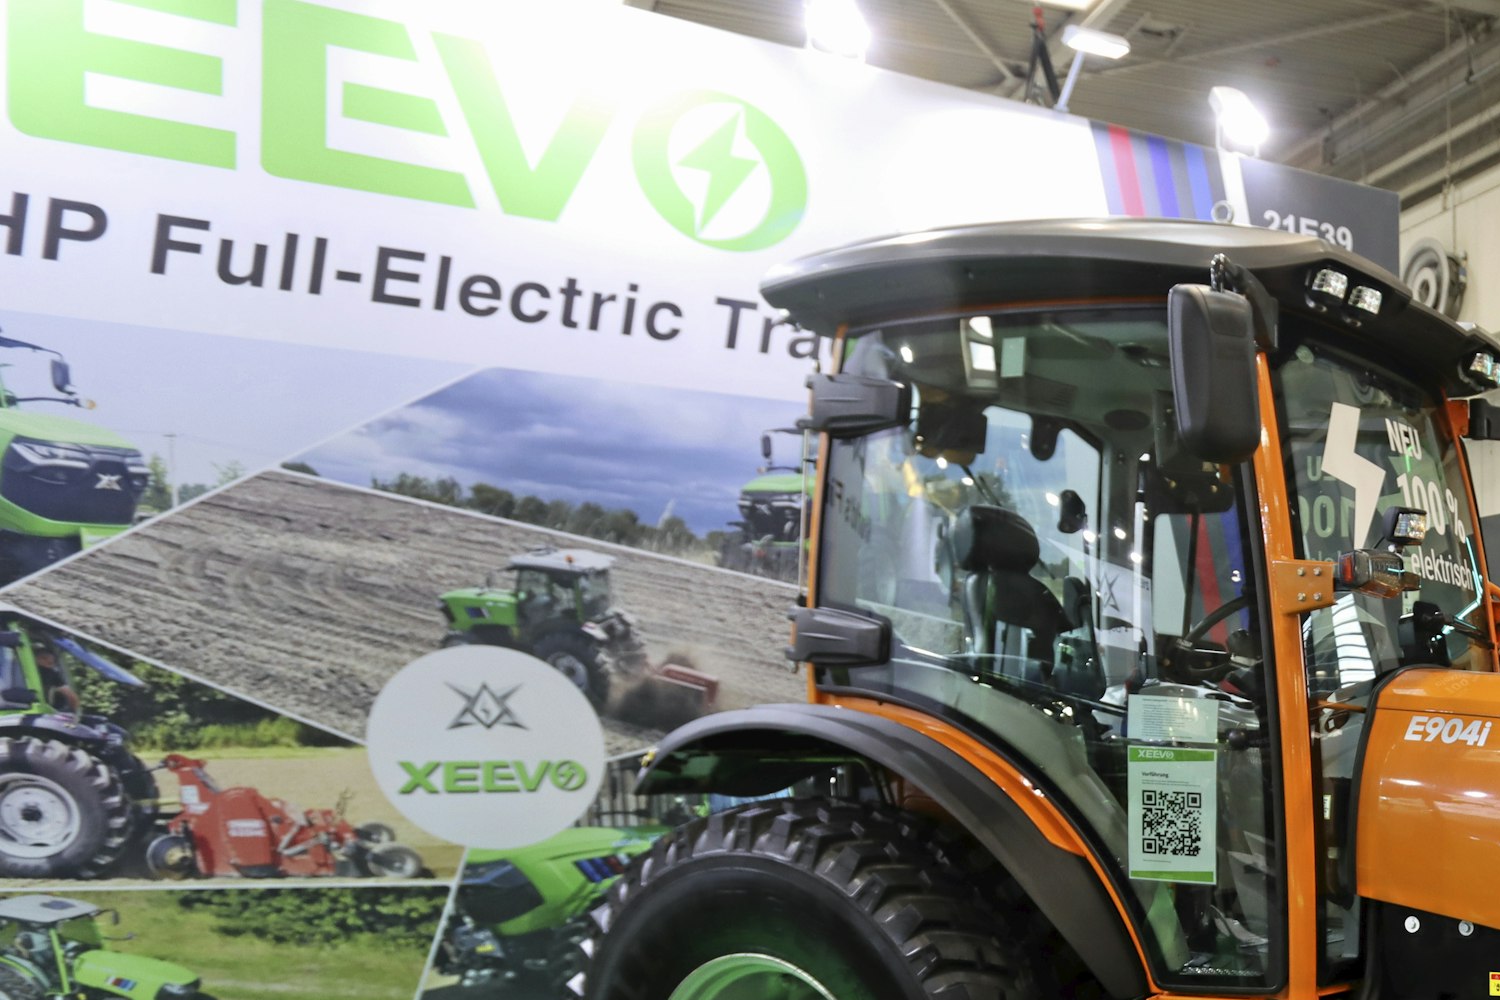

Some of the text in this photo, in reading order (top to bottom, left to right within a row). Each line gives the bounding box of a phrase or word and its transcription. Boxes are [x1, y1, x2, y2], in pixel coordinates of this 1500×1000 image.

[149, 213, 684, 342] Full-Electric
[714, 297, 834, 362] Tra
[1385, 418, 1422, 460] NEU
[1397, 473, 1446, 535] 100
[1411, 545, 1474, 591] elektrisch
[1404, 715, 1492, 747] E904i
[1137, 749, 1174, 760] XEEVO
[398, 760, 588, 795] XEEVO
